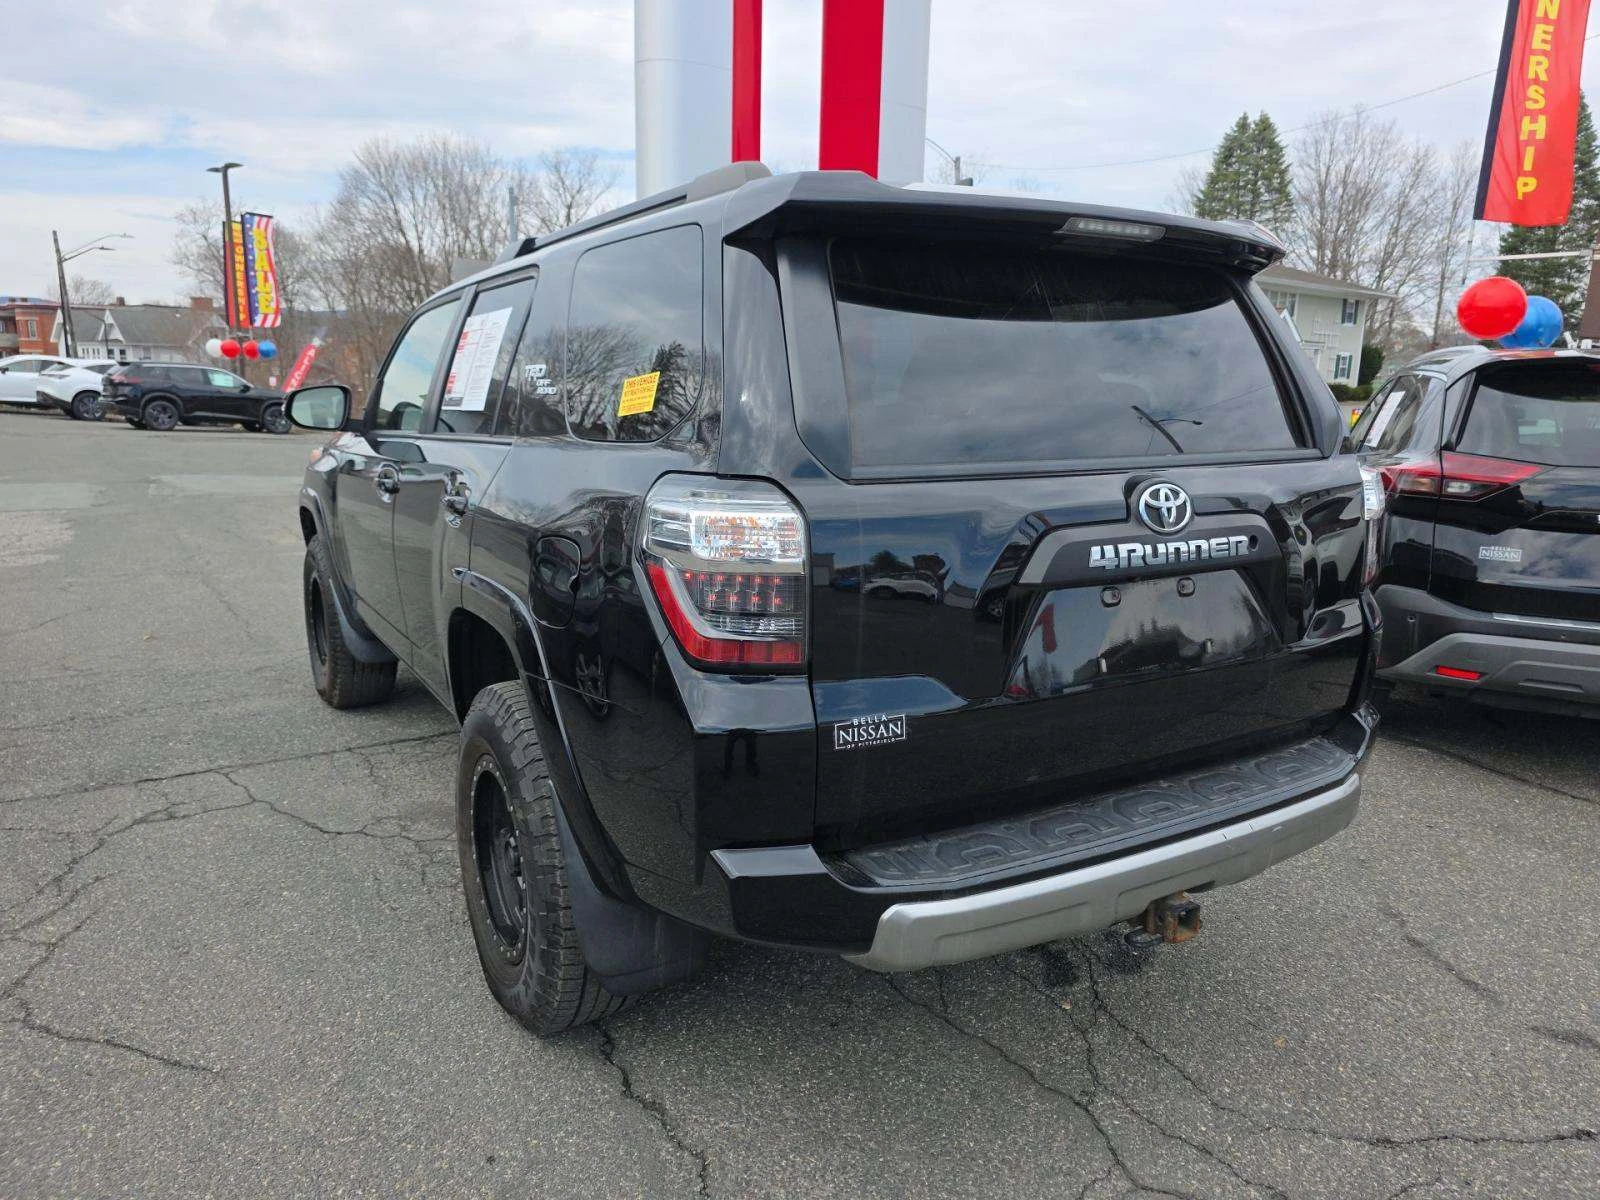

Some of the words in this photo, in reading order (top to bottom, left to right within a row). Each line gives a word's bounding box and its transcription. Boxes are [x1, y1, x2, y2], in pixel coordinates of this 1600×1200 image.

[253, 228, 275, 314] SALE
[853, 714, 888, 726] BELLA
[839, 721, 901, 744] NISSAN
